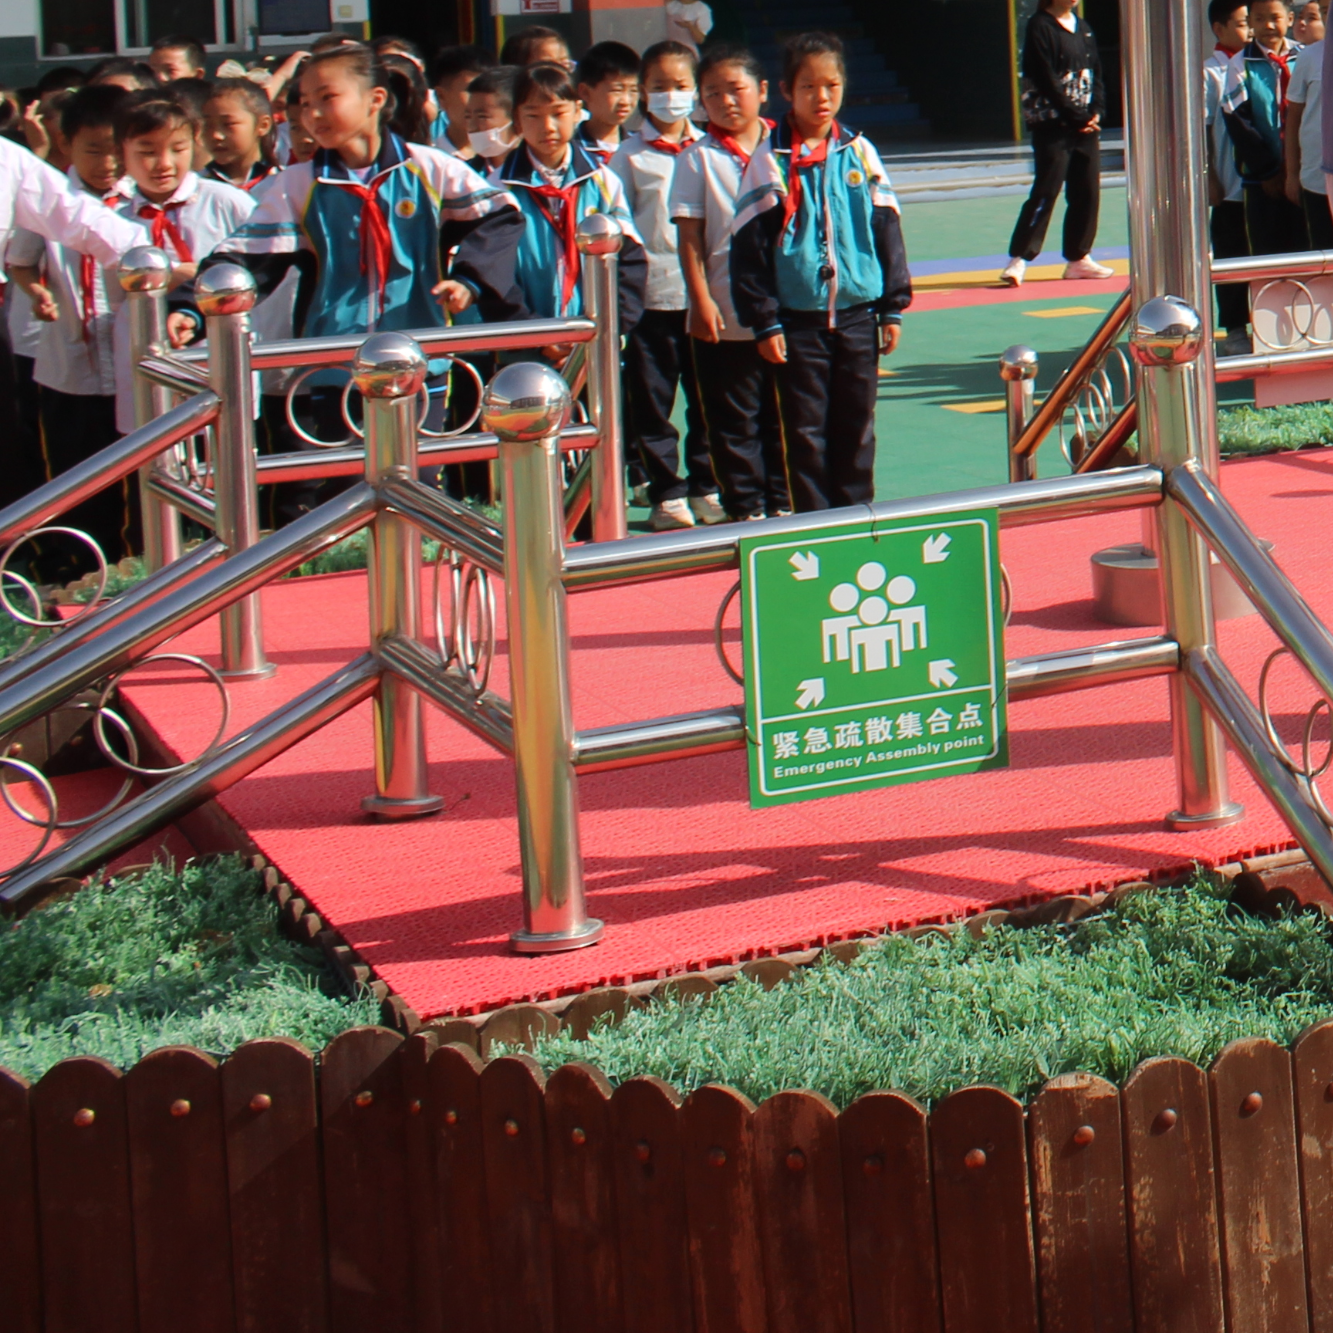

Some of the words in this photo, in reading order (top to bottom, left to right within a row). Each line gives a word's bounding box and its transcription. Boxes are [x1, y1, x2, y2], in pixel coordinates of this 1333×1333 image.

[772, 702, 983, 760] 紧急疏散集合点
[773, 756, 862, 779] Emergency
[865, 742, 941, 764] Assembly
[943, 733, 985, 752] point
